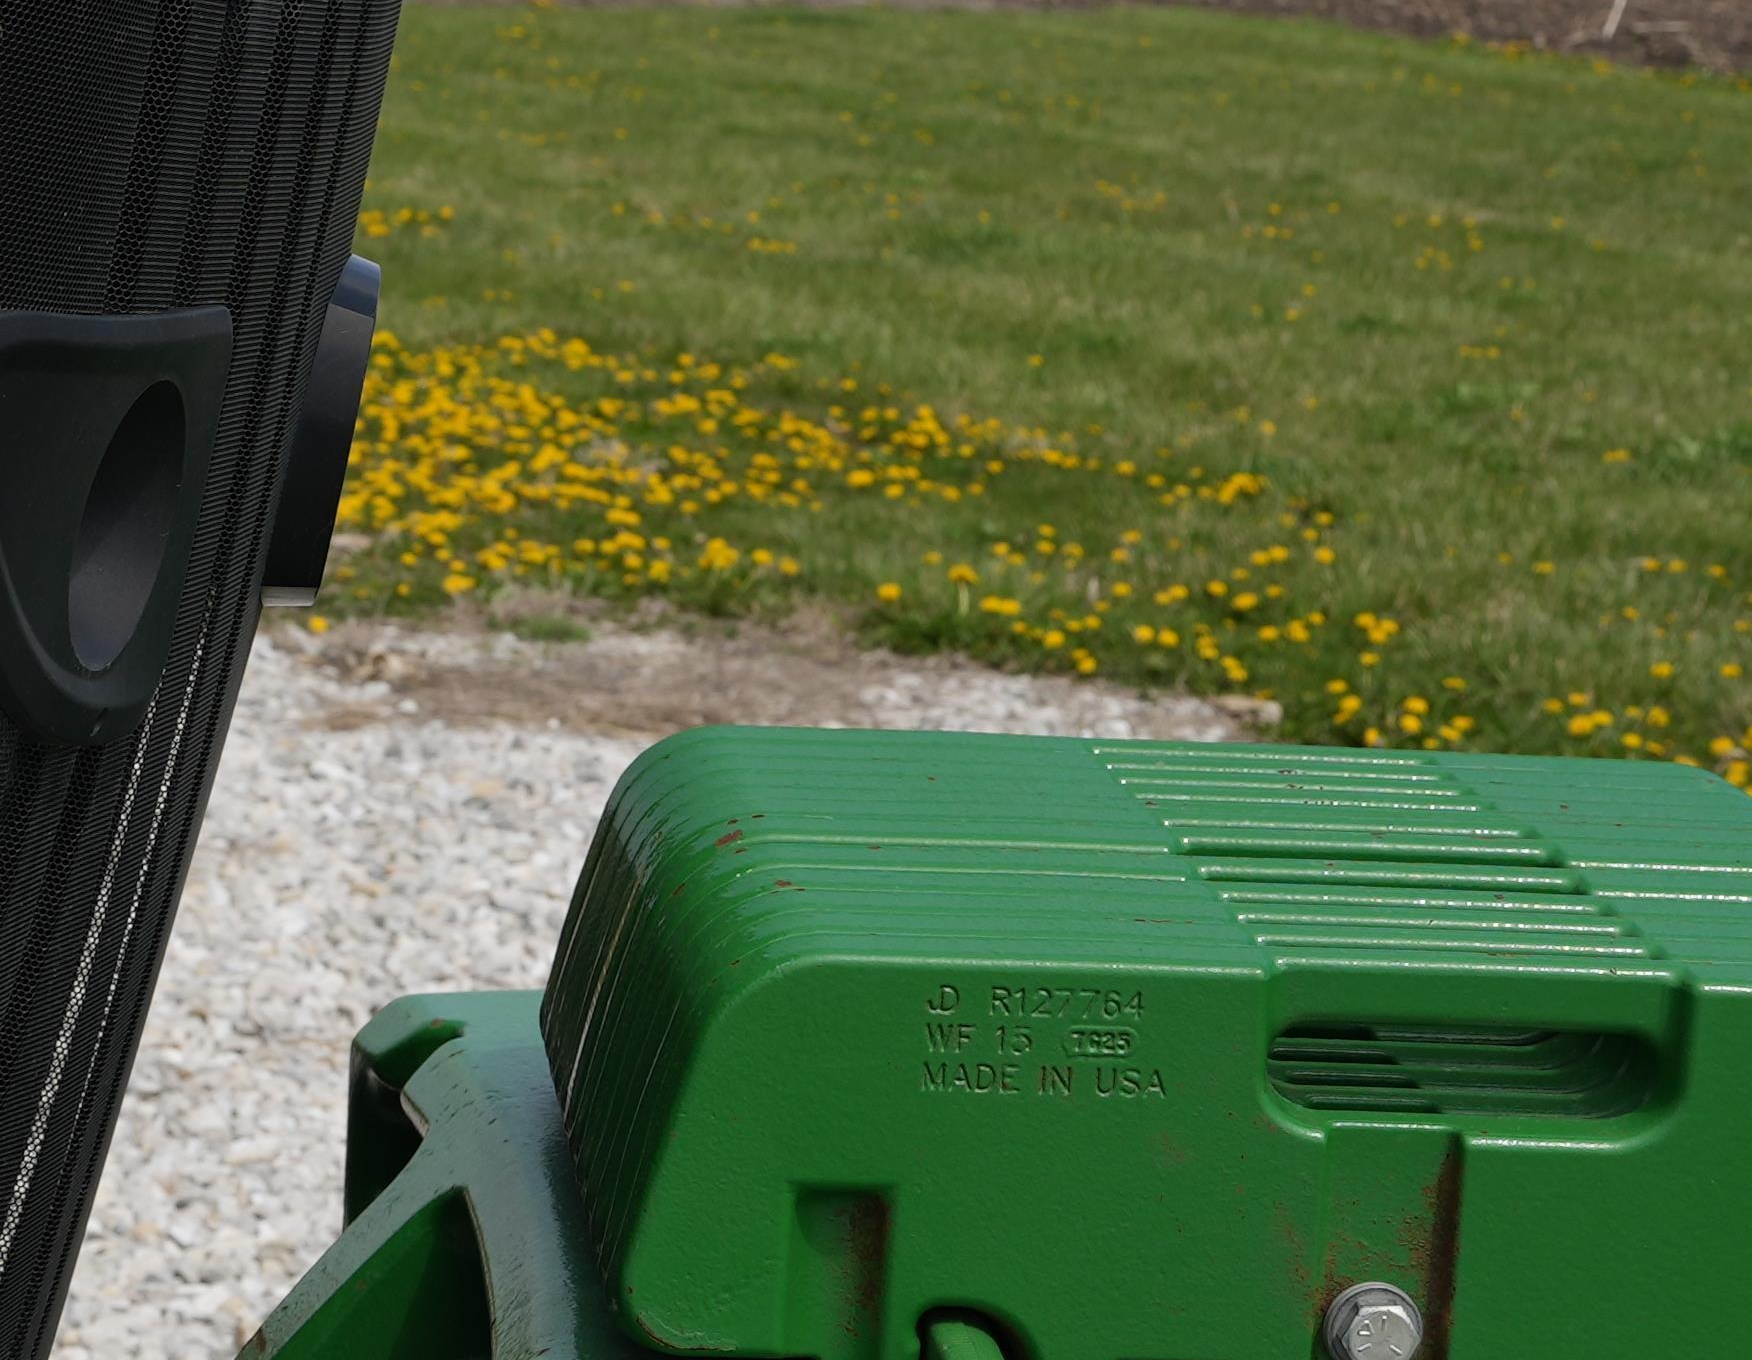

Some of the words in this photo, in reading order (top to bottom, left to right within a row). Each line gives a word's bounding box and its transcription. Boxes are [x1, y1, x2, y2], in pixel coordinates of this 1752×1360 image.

[926, 985, 961, 1015] JD
[989, 986, 1145, 1021] R127764
[926, 1022, 976, 1053] WF
[921, 1061, 1021, 1094] MADE
[1038, 1065, 1073, 1097] IN
[1095, 1067, 1167, 1099] USA
